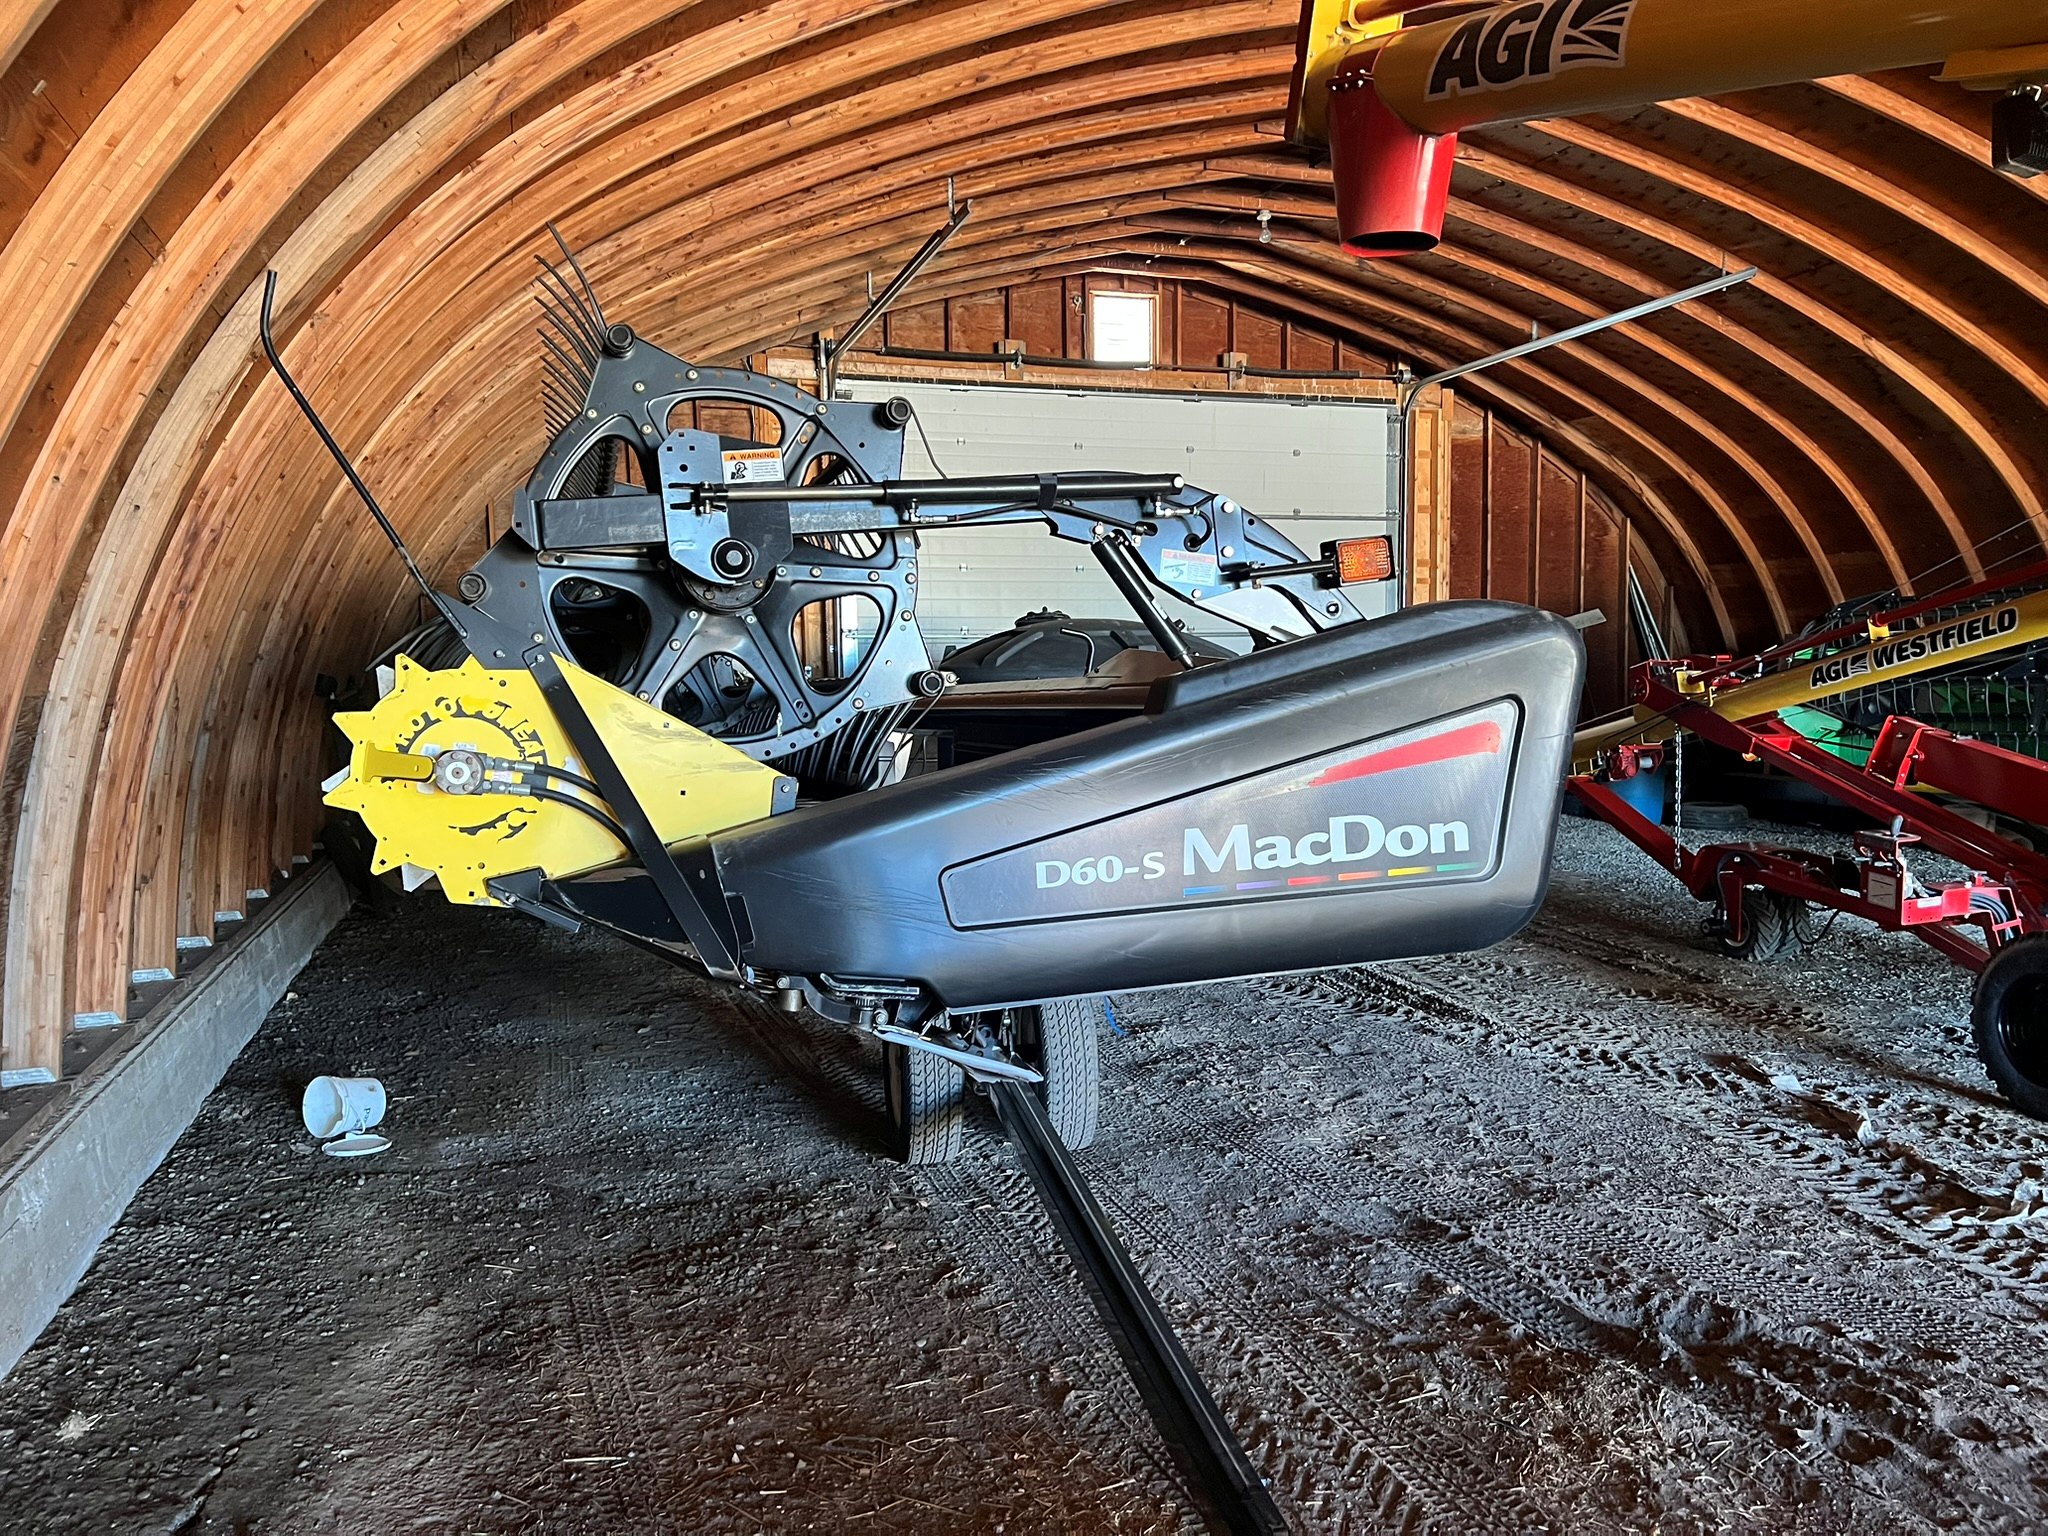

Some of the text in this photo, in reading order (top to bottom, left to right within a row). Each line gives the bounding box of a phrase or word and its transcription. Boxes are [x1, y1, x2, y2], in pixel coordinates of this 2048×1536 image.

[1428, 0, 1566, 97] AGI
[739, 451, 775, 460] WARNING
[1811, 608, 2018, 688] AGI WESTFIELD
[1035, 814, 1470, 889] D60-S MacDon
